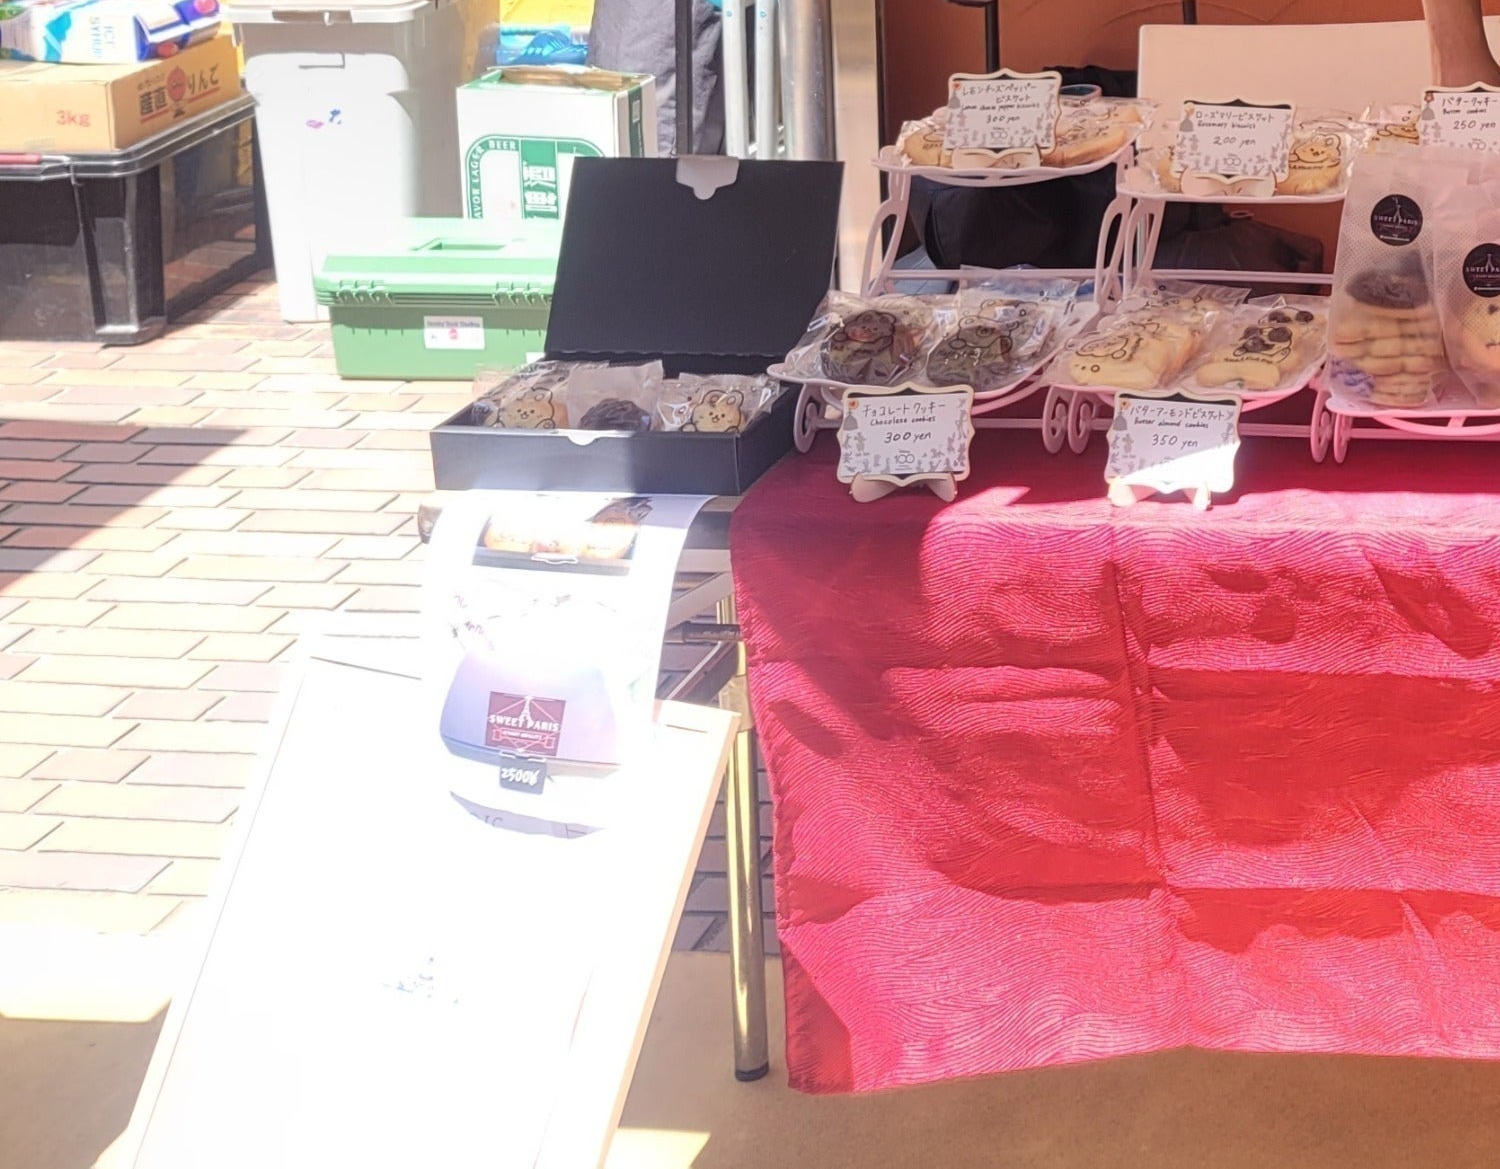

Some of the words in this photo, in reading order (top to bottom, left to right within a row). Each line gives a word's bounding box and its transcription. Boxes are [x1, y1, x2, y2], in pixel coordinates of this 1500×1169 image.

[56, 110, 91, 128] 3kg
[986, 115, 1005, 124] 300
[1007, 116, 1021, 124] yen
[1453, 120, 1477, 130] 250
[1480, 122, 1497, 132] yen
[1212, 136, 1238, 146] 200
[1239, 139, 1257, 149] yen
[469, 144, 486, 184] LAGER
[488, 139, 517, 150] BEER
[884, 431, 912, 444] 300
[913, 432, 932, 443] yen
[1152, 433, 1178, 446] 350
[1181, 439, 1198, 450] yen
[488, 714, 524, 729] SWEET
[526, 719, 560, 733] PARIS
